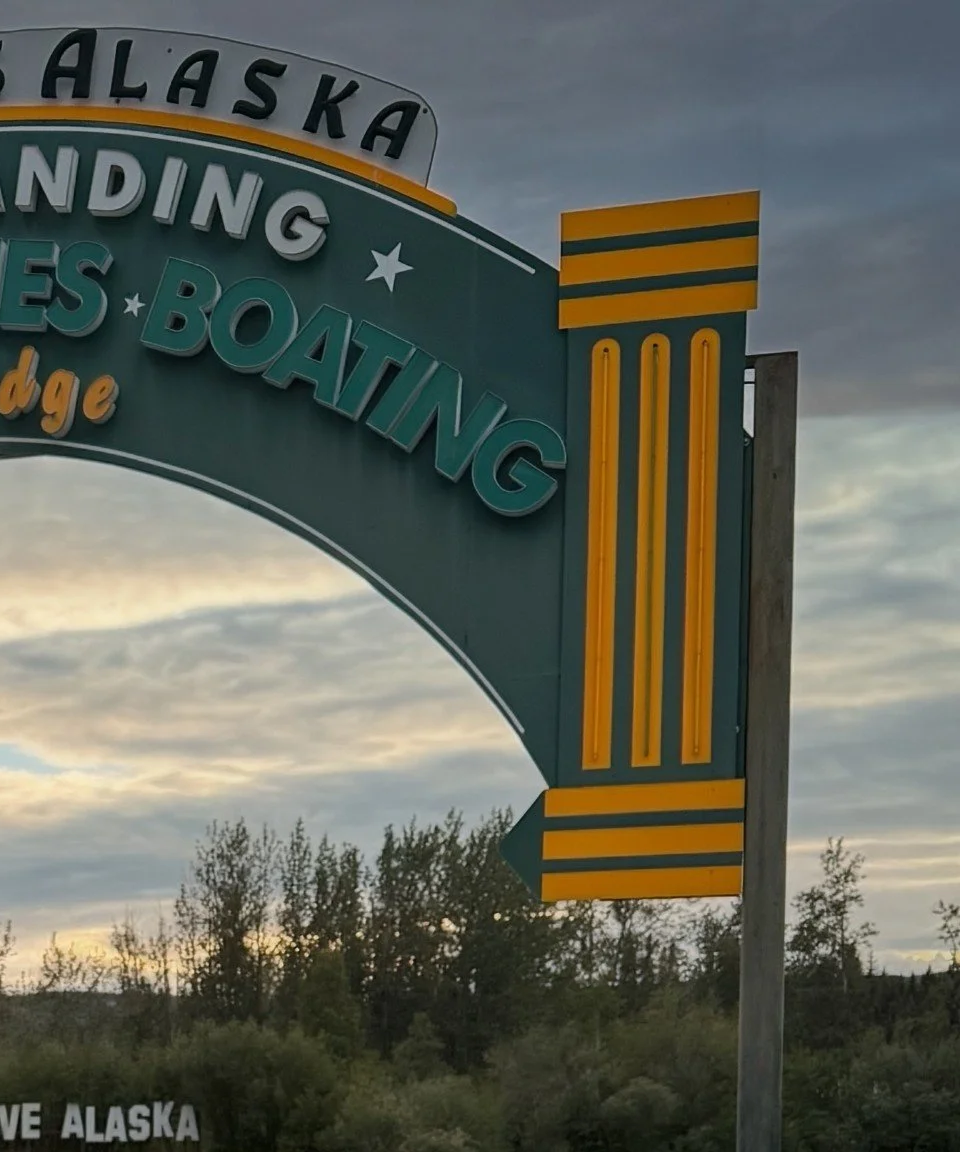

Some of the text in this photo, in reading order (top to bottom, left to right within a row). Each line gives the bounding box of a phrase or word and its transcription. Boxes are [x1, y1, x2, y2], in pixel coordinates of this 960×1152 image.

[40, 27, 421, 159] ALASKA
[140, 257, 567, 517] BOATING
[61, 1101, 199, 1142] ALASKA
